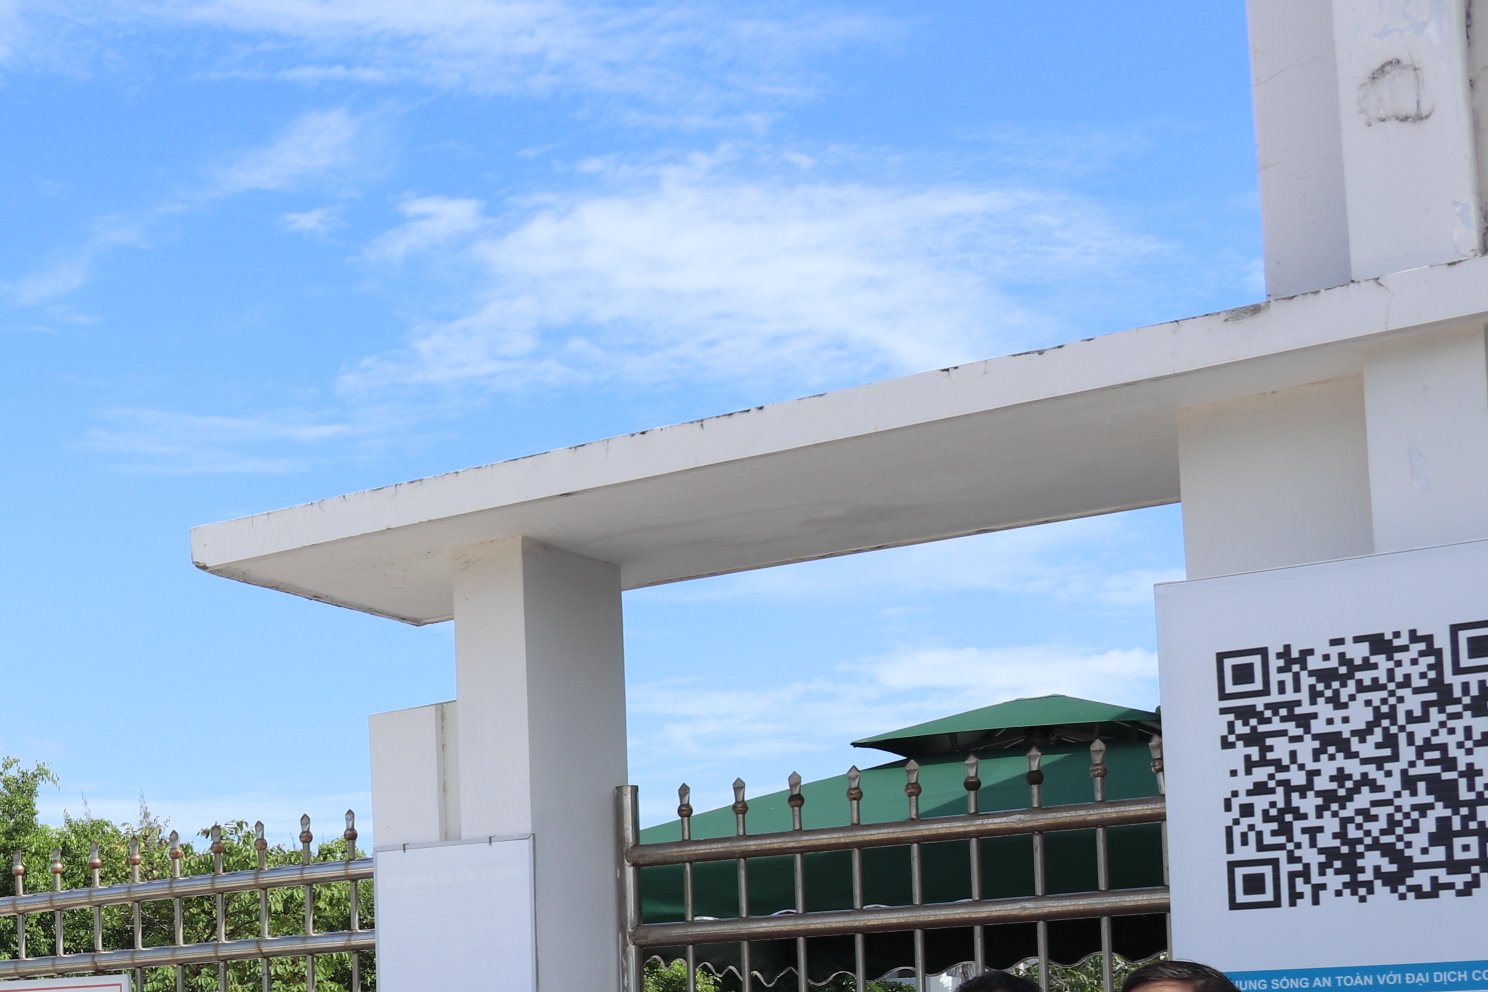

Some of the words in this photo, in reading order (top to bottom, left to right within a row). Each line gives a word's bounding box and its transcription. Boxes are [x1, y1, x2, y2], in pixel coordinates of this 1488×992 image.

[1313, 976, 1332, 988] AN
[1336, 972, 1373, 988] TOÀN
[1405, 971, 1429, 986] ĐẠI
[1433, 970, 1468, 985] DỊCH
